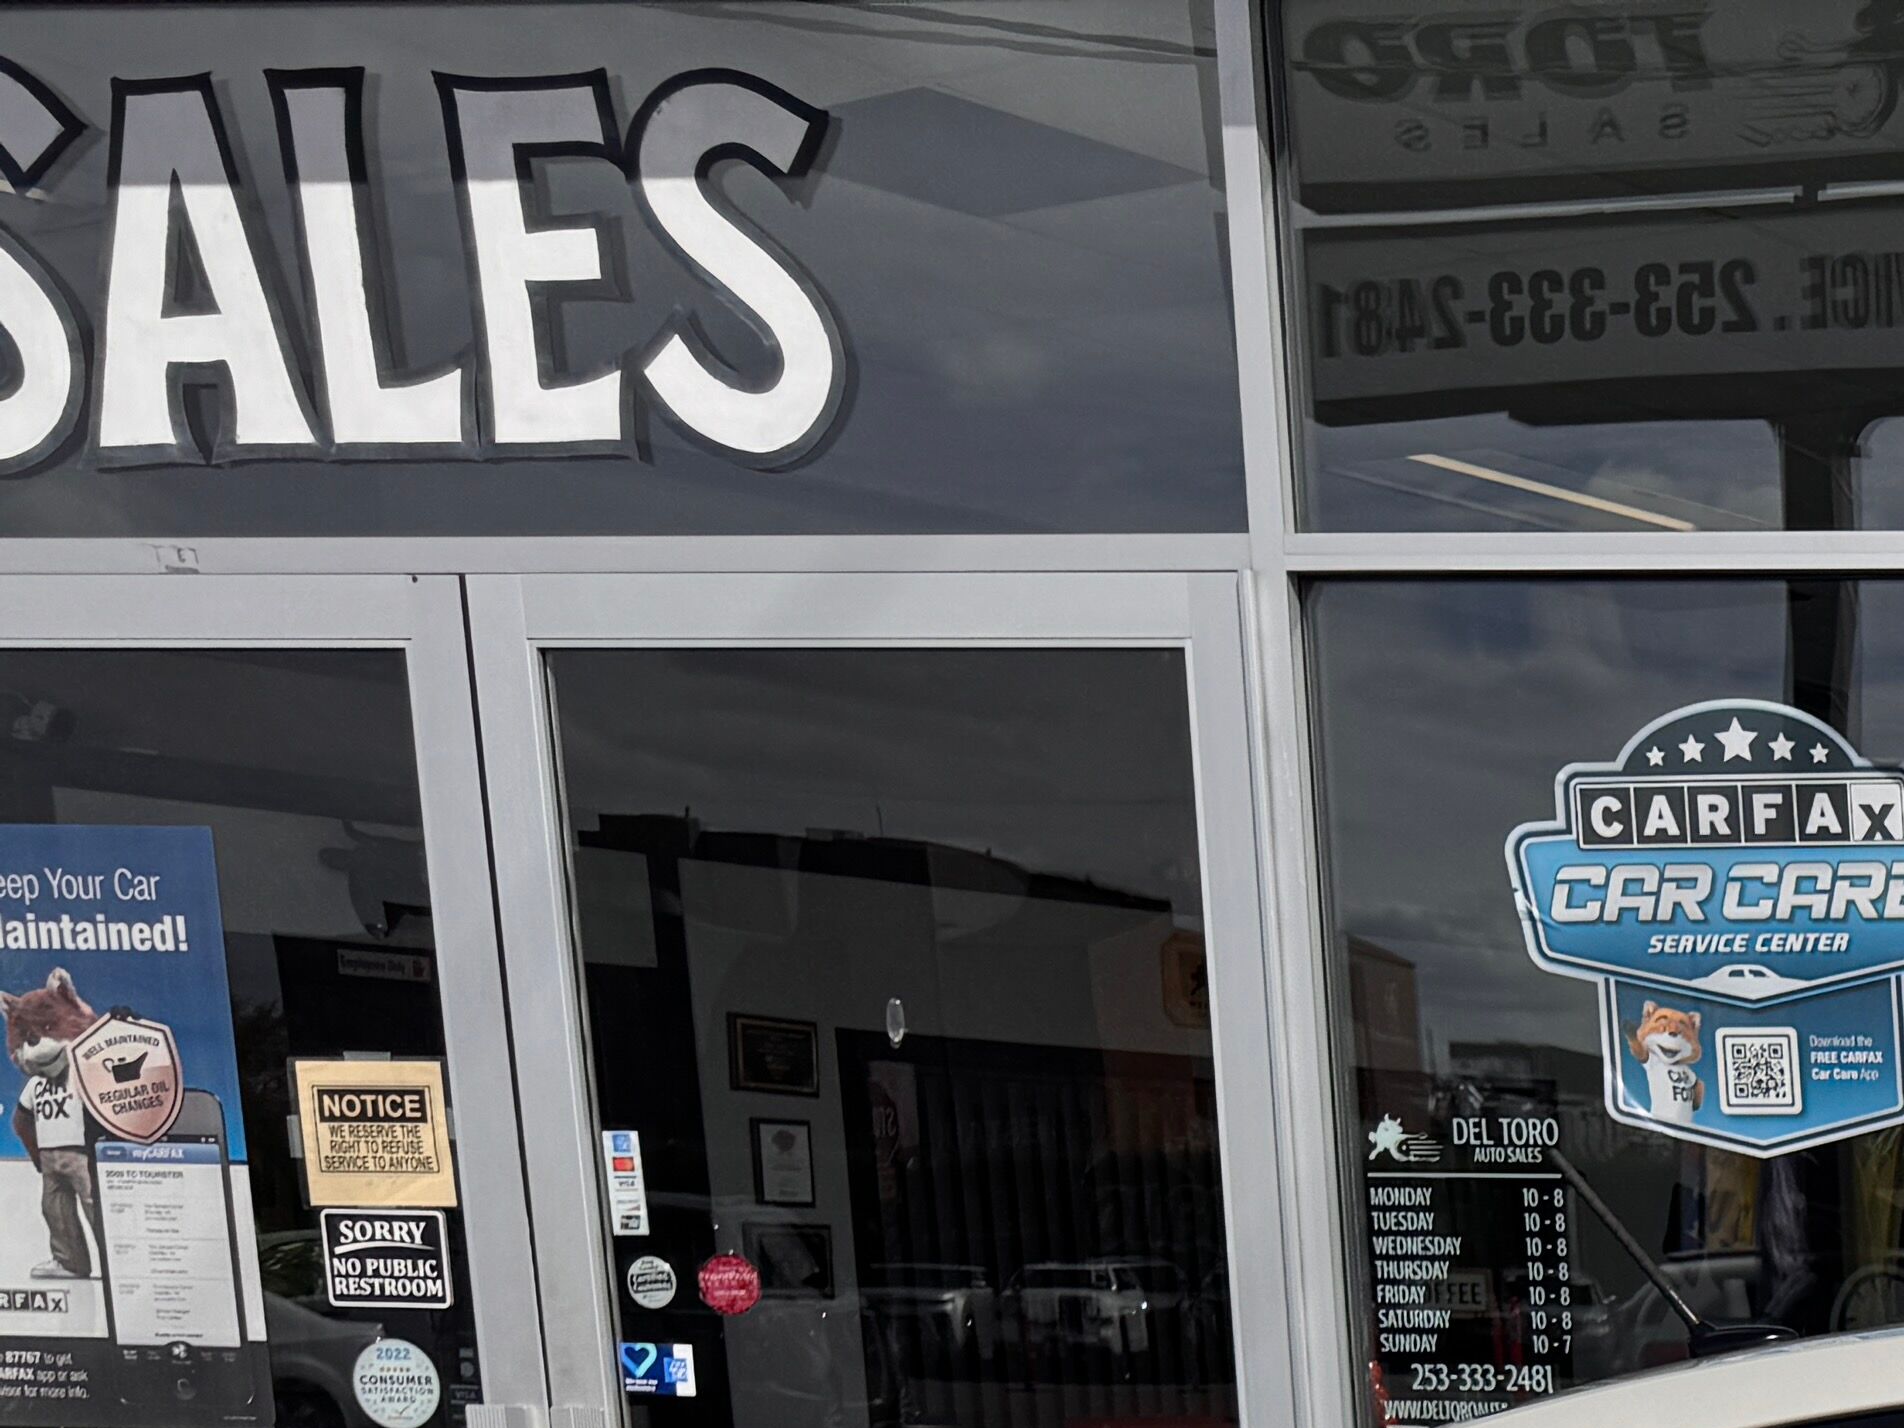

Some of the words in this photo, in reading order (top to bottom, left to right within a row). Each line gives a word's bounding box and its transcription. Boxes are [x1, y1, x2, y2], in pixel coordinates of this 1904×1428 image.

[1590, 792, 1902, 841] CARFAX
[44, 867, 104, 901] Your
[114, 868, 160, 901] Car
[1550, 862, 1714, 923] CAR
[1647, 933, 1750, 954] SERVICE
[1754, 932, 1849, 953] CENTER
[1809, 1034, 1855, 1048] Download
[1857, 1034, 1873, 1047] the
[1810, 1052, 1838, 1064] FREE
[1840, 1052, 1883, 1064] CARFAX
[1811, 1068, 1831, 1081] Car
[1833, 1068, 1859, 1081] Care
[323, 1094, 422, 1118] NOTICE
[329, 1125, 347, 1138] WE
[350, 1125, 399, 1138] RESERVE
[402, 1125, 421, 1138] THE
[1452, 1117, 1493, 1145] DEL
[1499, 1118, 1559, 1147] TORO
[331, 1140, 362, 1154] RIGHT
[364, 1141, 379, 1154] TO
[381, 1141, 424, 1155] REFUSE
[1474, 1147, 1505, 1163] AUTO
[1507, 1148, 1543, 1163] SALES
[324, 1156, 369, 1170] SERVICE
[372, 1157, 386, 1170] TO
[389, 1157, 434, 1171] ANYONE
[1370, 1187, 1432, 1206] MONDAY
[1372, 1212, 1434, 1231] TUESDAY
[339, 1220, 426, 1244] SORRY
[1373, 1236, 1462, 1256] WEDNESDAY
[332, 1258, 361, 1276] NO
[366, 1259, 438, 1277] PUBLIC
[1375, 1261, 1450, 1280] THURSDAY
[335, 1277, 444, 1297] RESTROOM
[1377, 1286, 1426, 1305] FRIDAY
[1378, 1309, 1451, 1329] SATURDAY
[1380, 1334, 1438, 1353] SUNDAY
[5, 1351, 41, 1364] 87767
[376, 1347, 412, 1360] 2022
[360, 1375, 433, 1386] CONSUMER
[1410, 1363, 1555, 1394] 253-333-2481
[360, 1386, 434, 1395] SATISFACTION
